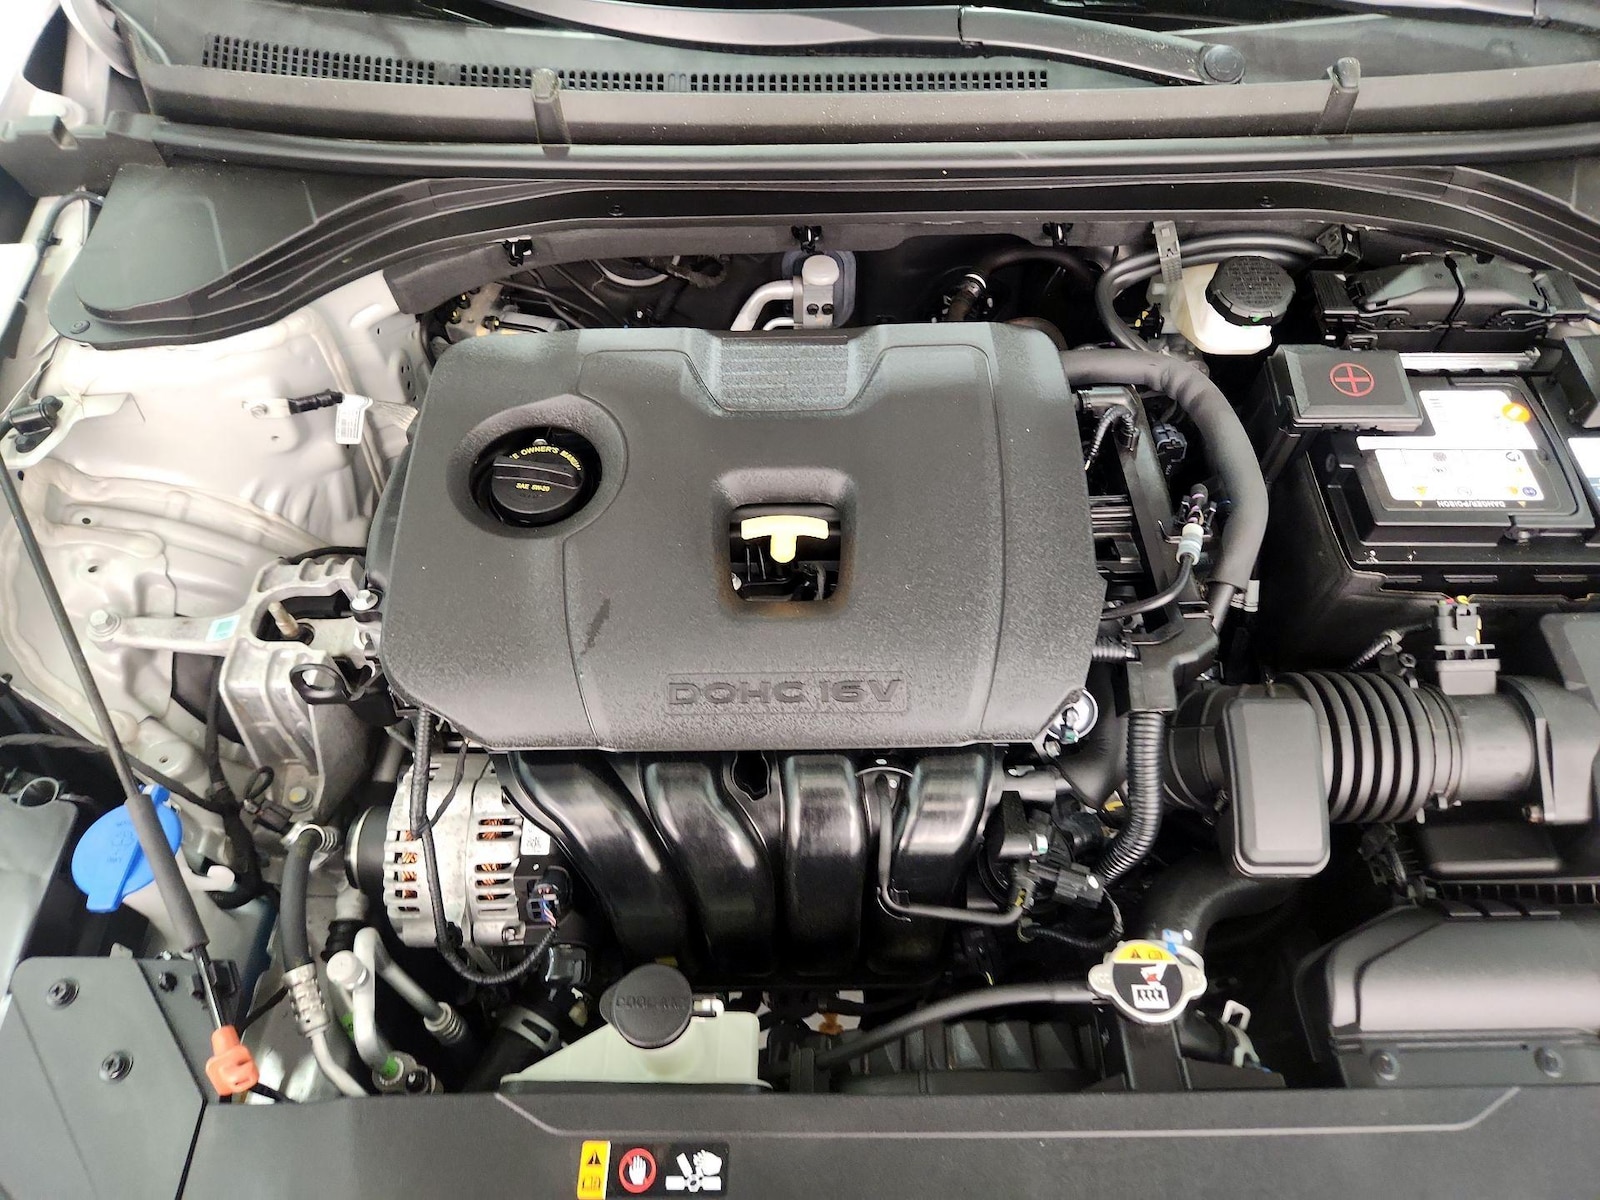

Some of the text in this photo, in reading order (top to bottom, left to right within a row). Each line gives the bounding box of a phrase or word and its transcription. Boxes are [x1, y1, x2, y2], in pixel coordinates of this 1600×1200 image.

[521, 446, 560, 456] OWNER'S
[668, 679, 902, 705] DOHC 16V
